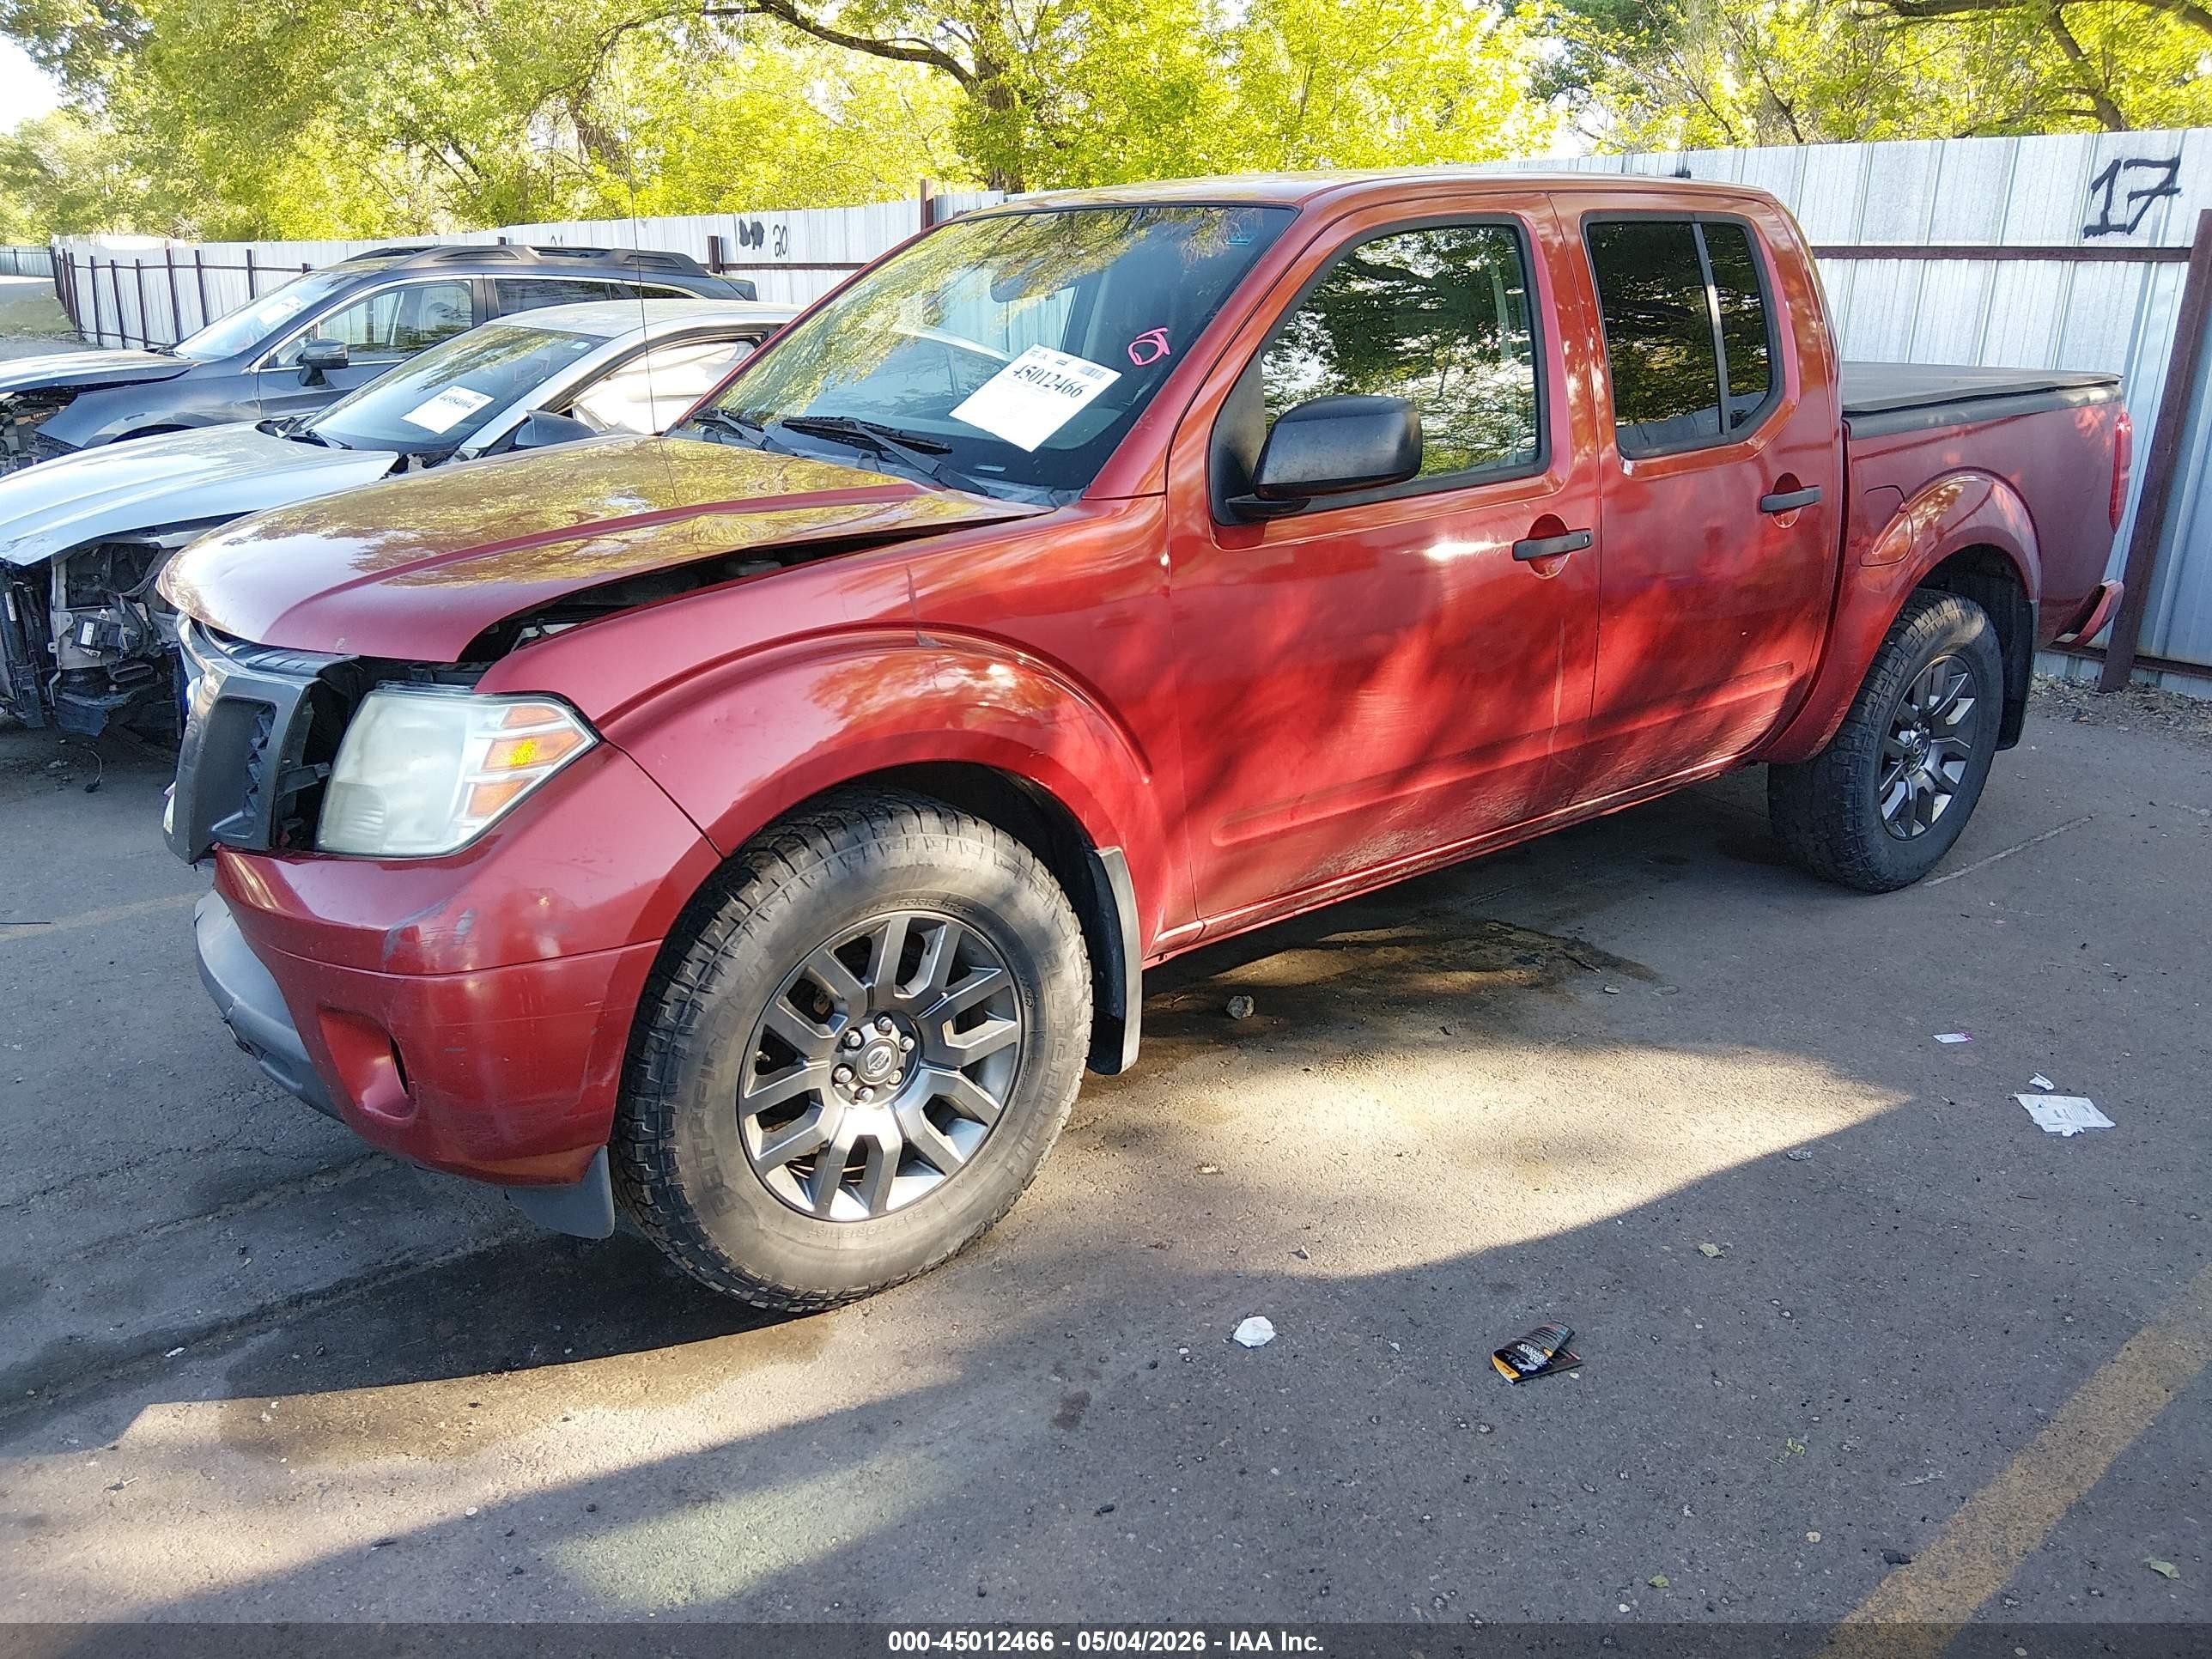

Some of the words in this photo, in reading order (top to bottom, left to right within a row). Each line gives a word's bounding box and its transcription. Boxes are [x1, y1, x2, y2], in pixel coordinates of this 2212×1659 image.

[2083, 155, 2182, 239] 17
[773, 224, 787, 258] 20
[1012, 364, 1090, 398] 45012466
